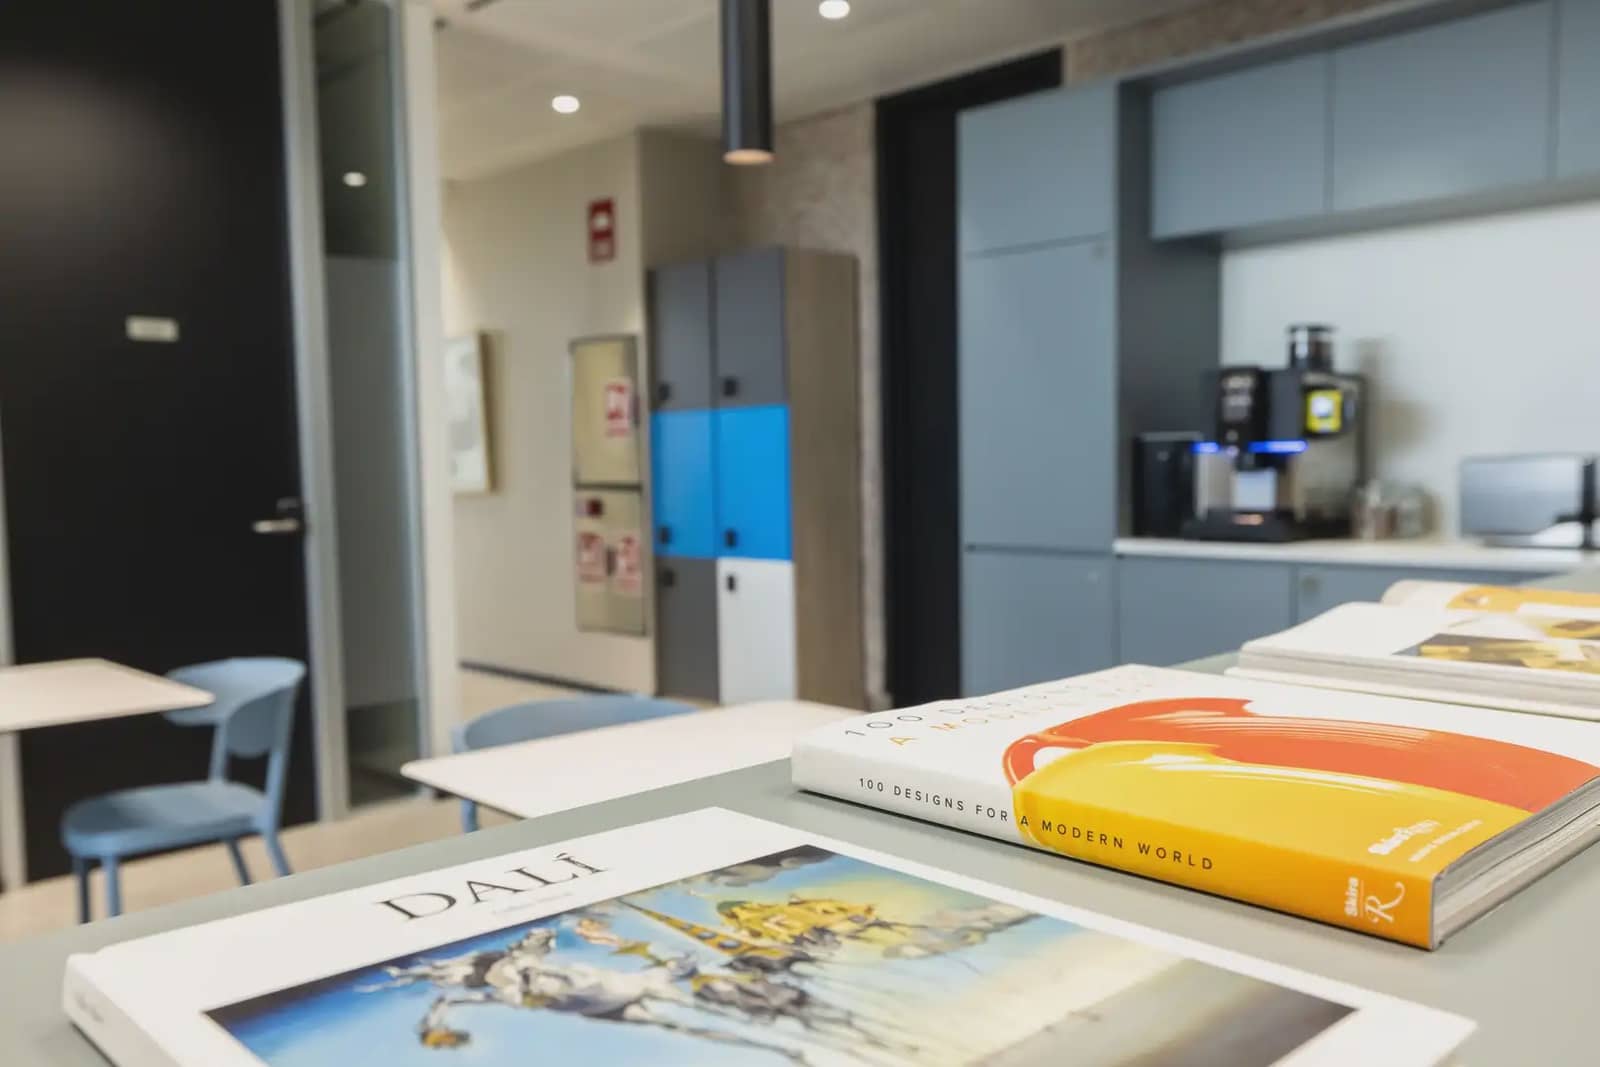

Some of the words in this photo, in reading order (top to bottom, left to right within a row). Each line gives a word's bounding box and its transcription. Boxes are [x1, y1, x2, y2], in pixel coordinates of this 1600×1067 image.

[844, 714, 923, 736] 100
[889, 736, 917, 746] A
[859, 778, 884, 792] 100
[893, 785, 965, 811] DESIGNS
[975, 805, 1008, 822] FOR
[1020, 815, 1029, 826] A
[1041, 820, 1123, 849] MODERN
[1137, 842, 1213, 870] WORLD
[374, 851, 607, 922] DALÍ
